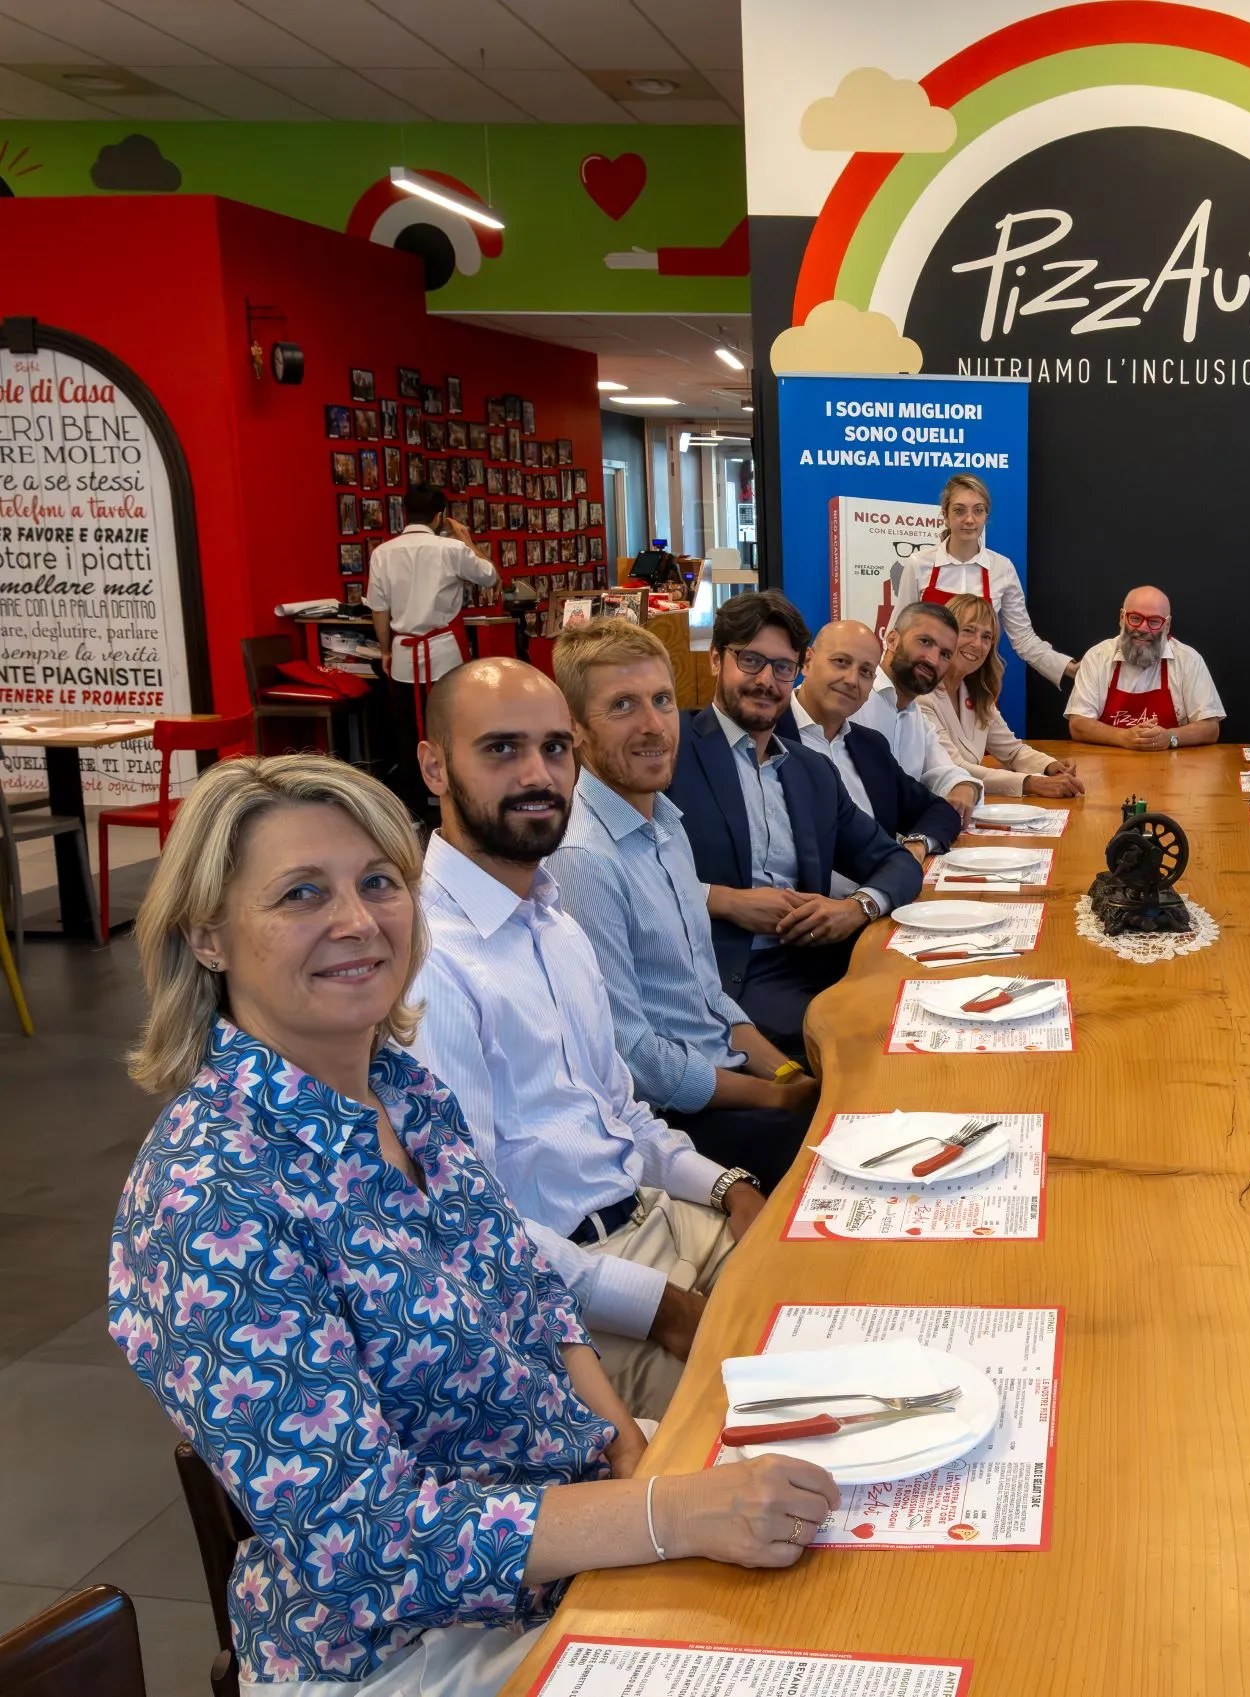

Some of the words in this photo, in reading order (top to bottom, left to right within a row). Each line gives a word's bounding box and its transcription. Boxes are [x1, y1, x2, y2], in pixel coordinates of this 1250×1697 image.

[958, 357, 1091, 384] NUTRIAMO
[31, 378, 53, 404] di
[59, 377, 115, 404] Casa
[826, 401, 831, 416] I
[836, 402, 893, 418] SOGNI
[898, 403, 982, 419] MIGLIORI
[62, 415, 140, 441] BENE
[844, 426, 898, 442] SONO
[902, 427, 964, 445] QUELLI
[43, 445, 141, 464] MOLTO
[800, 450, 814, 465] A
[818, 450, 880, 466] LUNGA
[885, 451, 1009, 469] LIEVITAZIONE
[23, 474, 39, 491] a
[44, 474, 71, 491] se
[76, 471, 144, 492] stessi
[71, 505, 83, 518] a
[87, 495, 146, 519] tavola
[854, 511, 891, 524] NICO
[895, 515, 945, 529] ACAMP
[17, 527, 73, 542] FAVORE
[80, 528, 88, 542] E
[94, 528, 149, 543] GRAZIE
[869, 527, 886, 535] CON
[887, 528, 932, 538] ELISABETTA
[66, 546, 71, 570] i
[82, 546, 151, 576] piatti
[0, 574, 95, 595] mollare
[103, 579, 153, 596] mai
[26, 599, 49, 617] CON
[51, 599, 67, 618] LA
[70, 600, 108, 619] PALLA
[112, 600, 156, 619] DENTRO
[32, 622, 102, 641] deglutire,
[107, 623, 158, 643] parlare
[1, 648, 69, 664] sempre
[75, 643, 95, 661] la
[102, 646, 159, 662] verità
[43, 667, 163, 687] PIAGNISTEI
[60, 690, 76, 704] LE
[82, 690, 164, 706] PROMESSE
[102, 760, 118, 773] TI
[128, 760, 171, 774] PIAC
[942, 1310, 951, 1328] BEVANDE
[1047, 1312, 1055, 1333] ANTIPASTI
[929, 1470, 939, 1496] DRATAZIONE
[944, 1472, 953, 1491] LIEVITA
[864, 1483, 892, 1515] PzzAut
[892, 1488, 902, 1508] NOSTRI
[901, 1490, 910, 1509] BUONA
[908, 1478, 921, 1517] LEGGERISSIMA
[950, 1483, 960, 1504] NOSTRA
[888, 1510, 898, 1528] SOGNI
[939, 1512, 947, 1524] ORE
[947, 1506, 956, 1522] PIZZA
[568, 1648, 584, 1667] WHISKY
[578, 1648, 592, 1665] AMARO
[640, 1652, 650, 1663] VINO
[722, 1658, 734, 1671] BIRRE
[629, 1665, 643, 1683] BIANCO
[688, 1666, 698, 1678] BEER
[744, 1659, 755, 1674] ACQUA
[784, 1661, 795, 1676] BIBITE
[816, 1664, 827, 1682] PATATINE
[575, 1665, 593, 1689] CORRETTO
[716, 1673, 726, 1684] ALLA
[778, 1678, 788, 1690] ALLA
[788, 1662, 807, 1696] BEVAND
